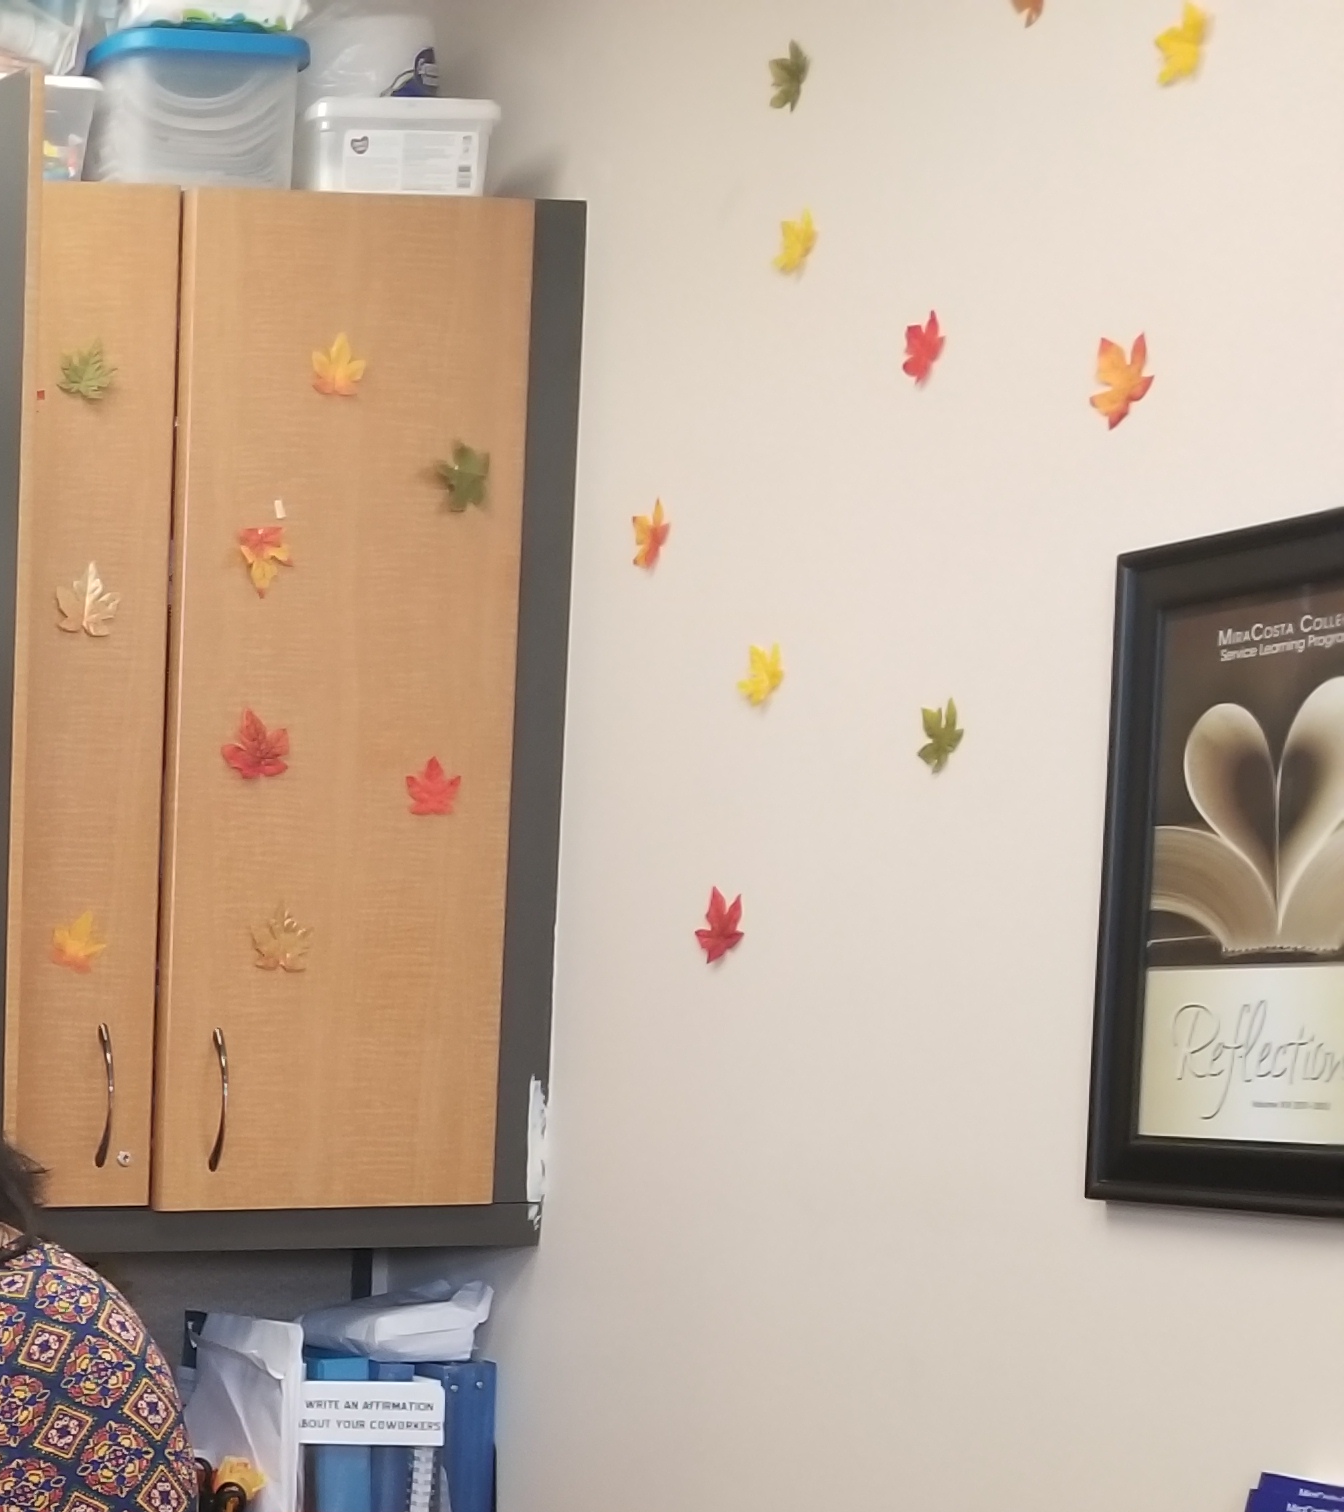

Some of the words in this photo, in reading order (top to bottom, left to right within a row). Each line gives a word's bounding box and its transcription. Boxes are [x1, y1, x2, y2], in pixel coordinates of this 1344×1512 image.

[1220, 646, 1257, 662] Service
[1259, 638, 1305, 656] Learning
[304, 1399, 341, 1412] WRITE
[343, 1399, 360, 1412] AN
[362, 1399, 435, 1412] AFFIRMATION
[335, 1418, 367, 1431] YOUR
[369, 1419, 442, 1432] COWORKERS
